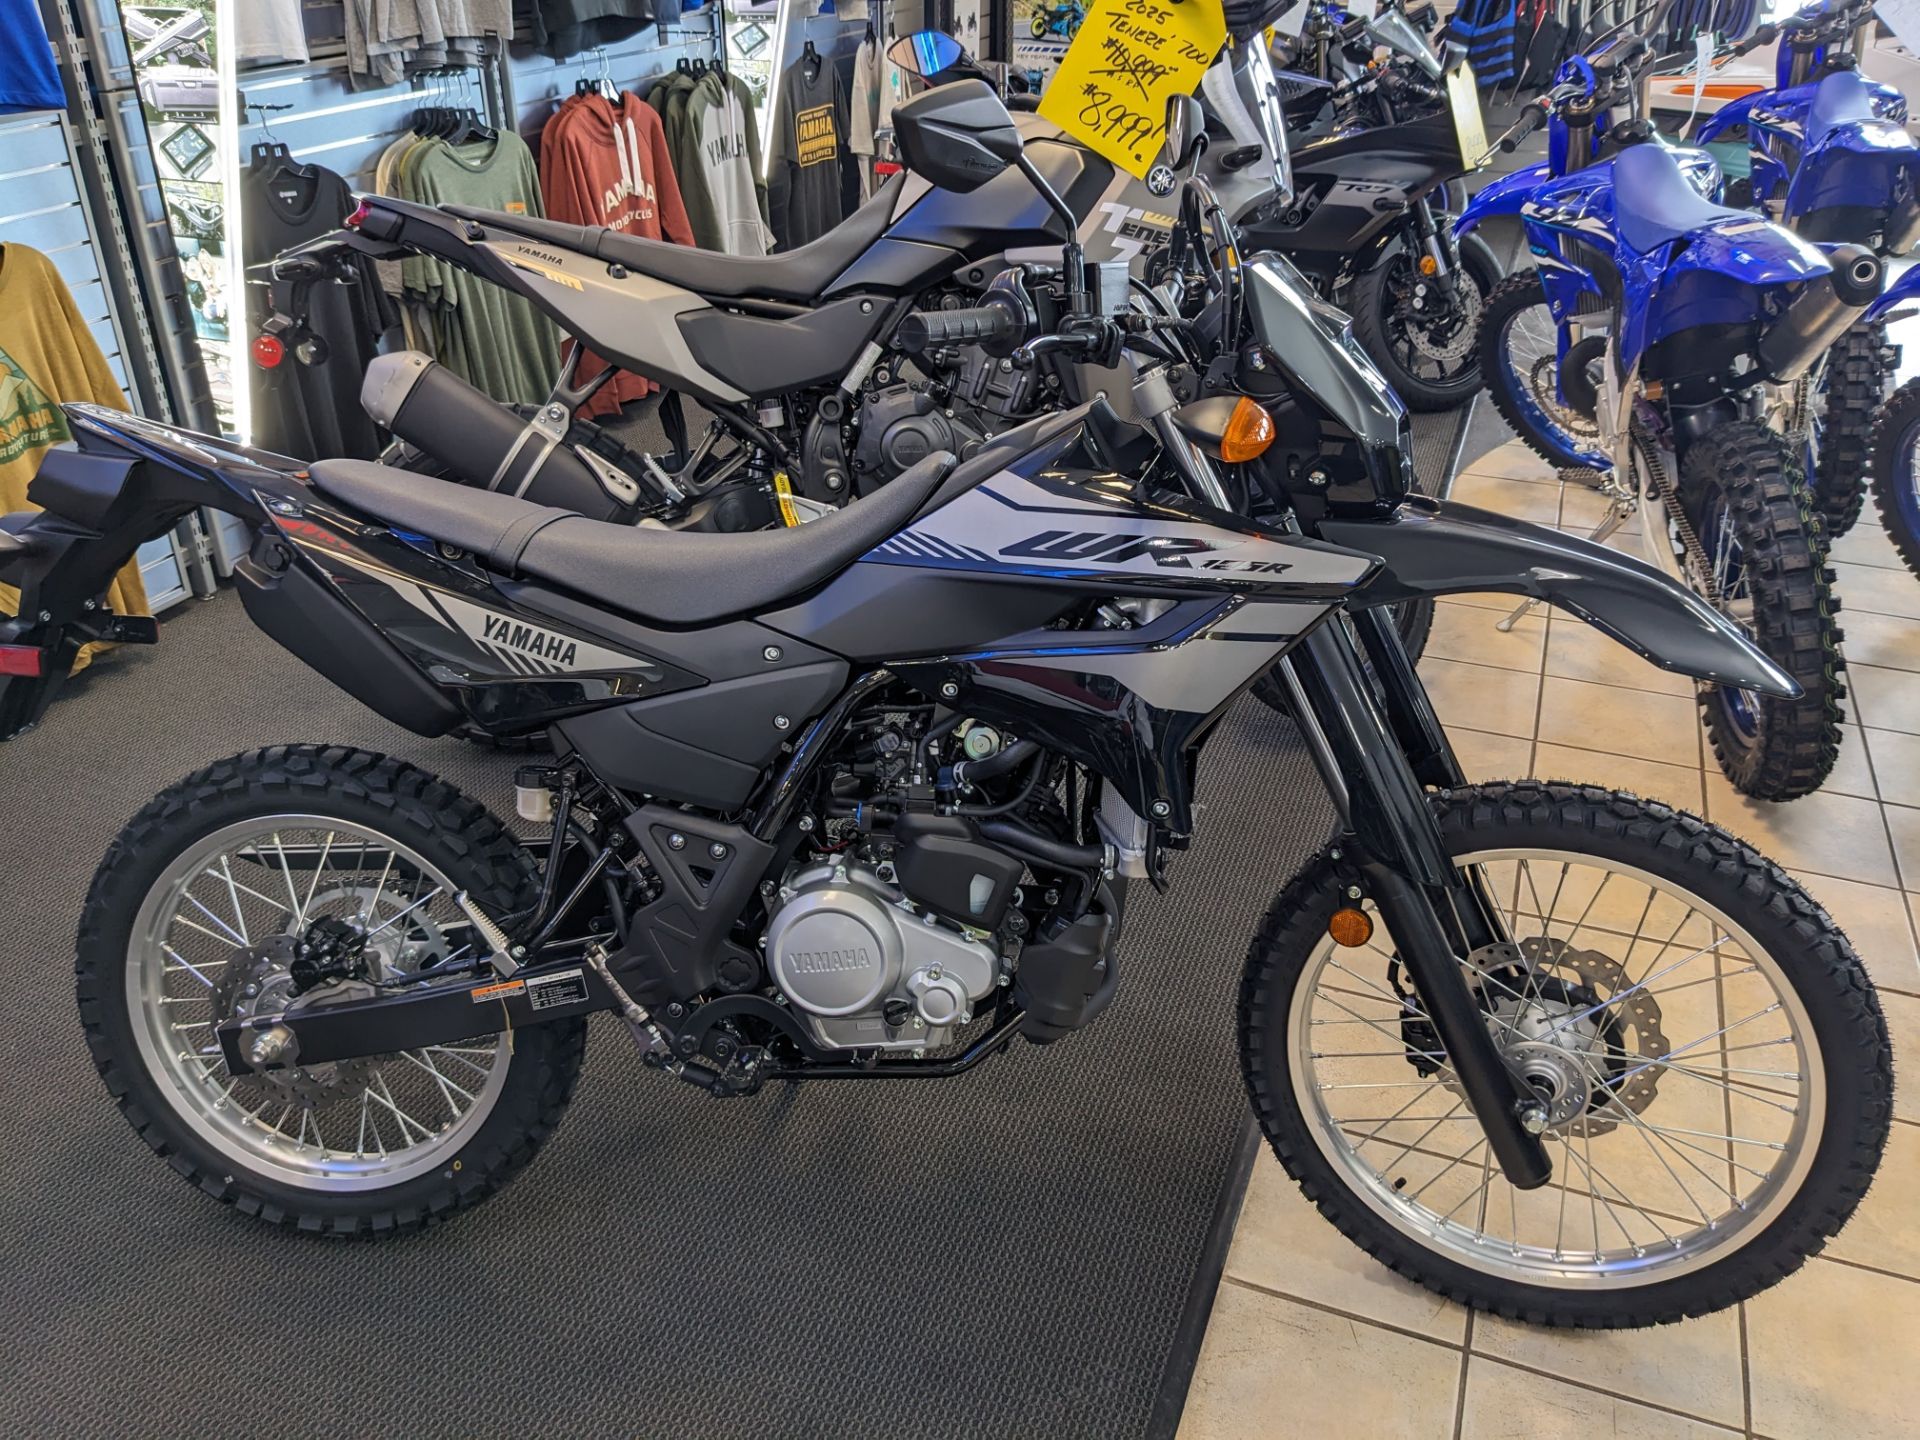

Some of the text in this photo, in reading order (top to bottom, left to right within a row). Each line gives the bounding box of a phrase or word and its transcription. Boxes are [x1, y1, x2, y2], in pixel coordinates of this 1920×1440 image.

[1177, 39, 1210, 65] 700
[517, 245, 564, 266] YAMAHA
[998, 530, 1238, 569] WR
[483, 614, 577, 666] YAMAHA
[789, 947, 871, 973] YAMAHA
